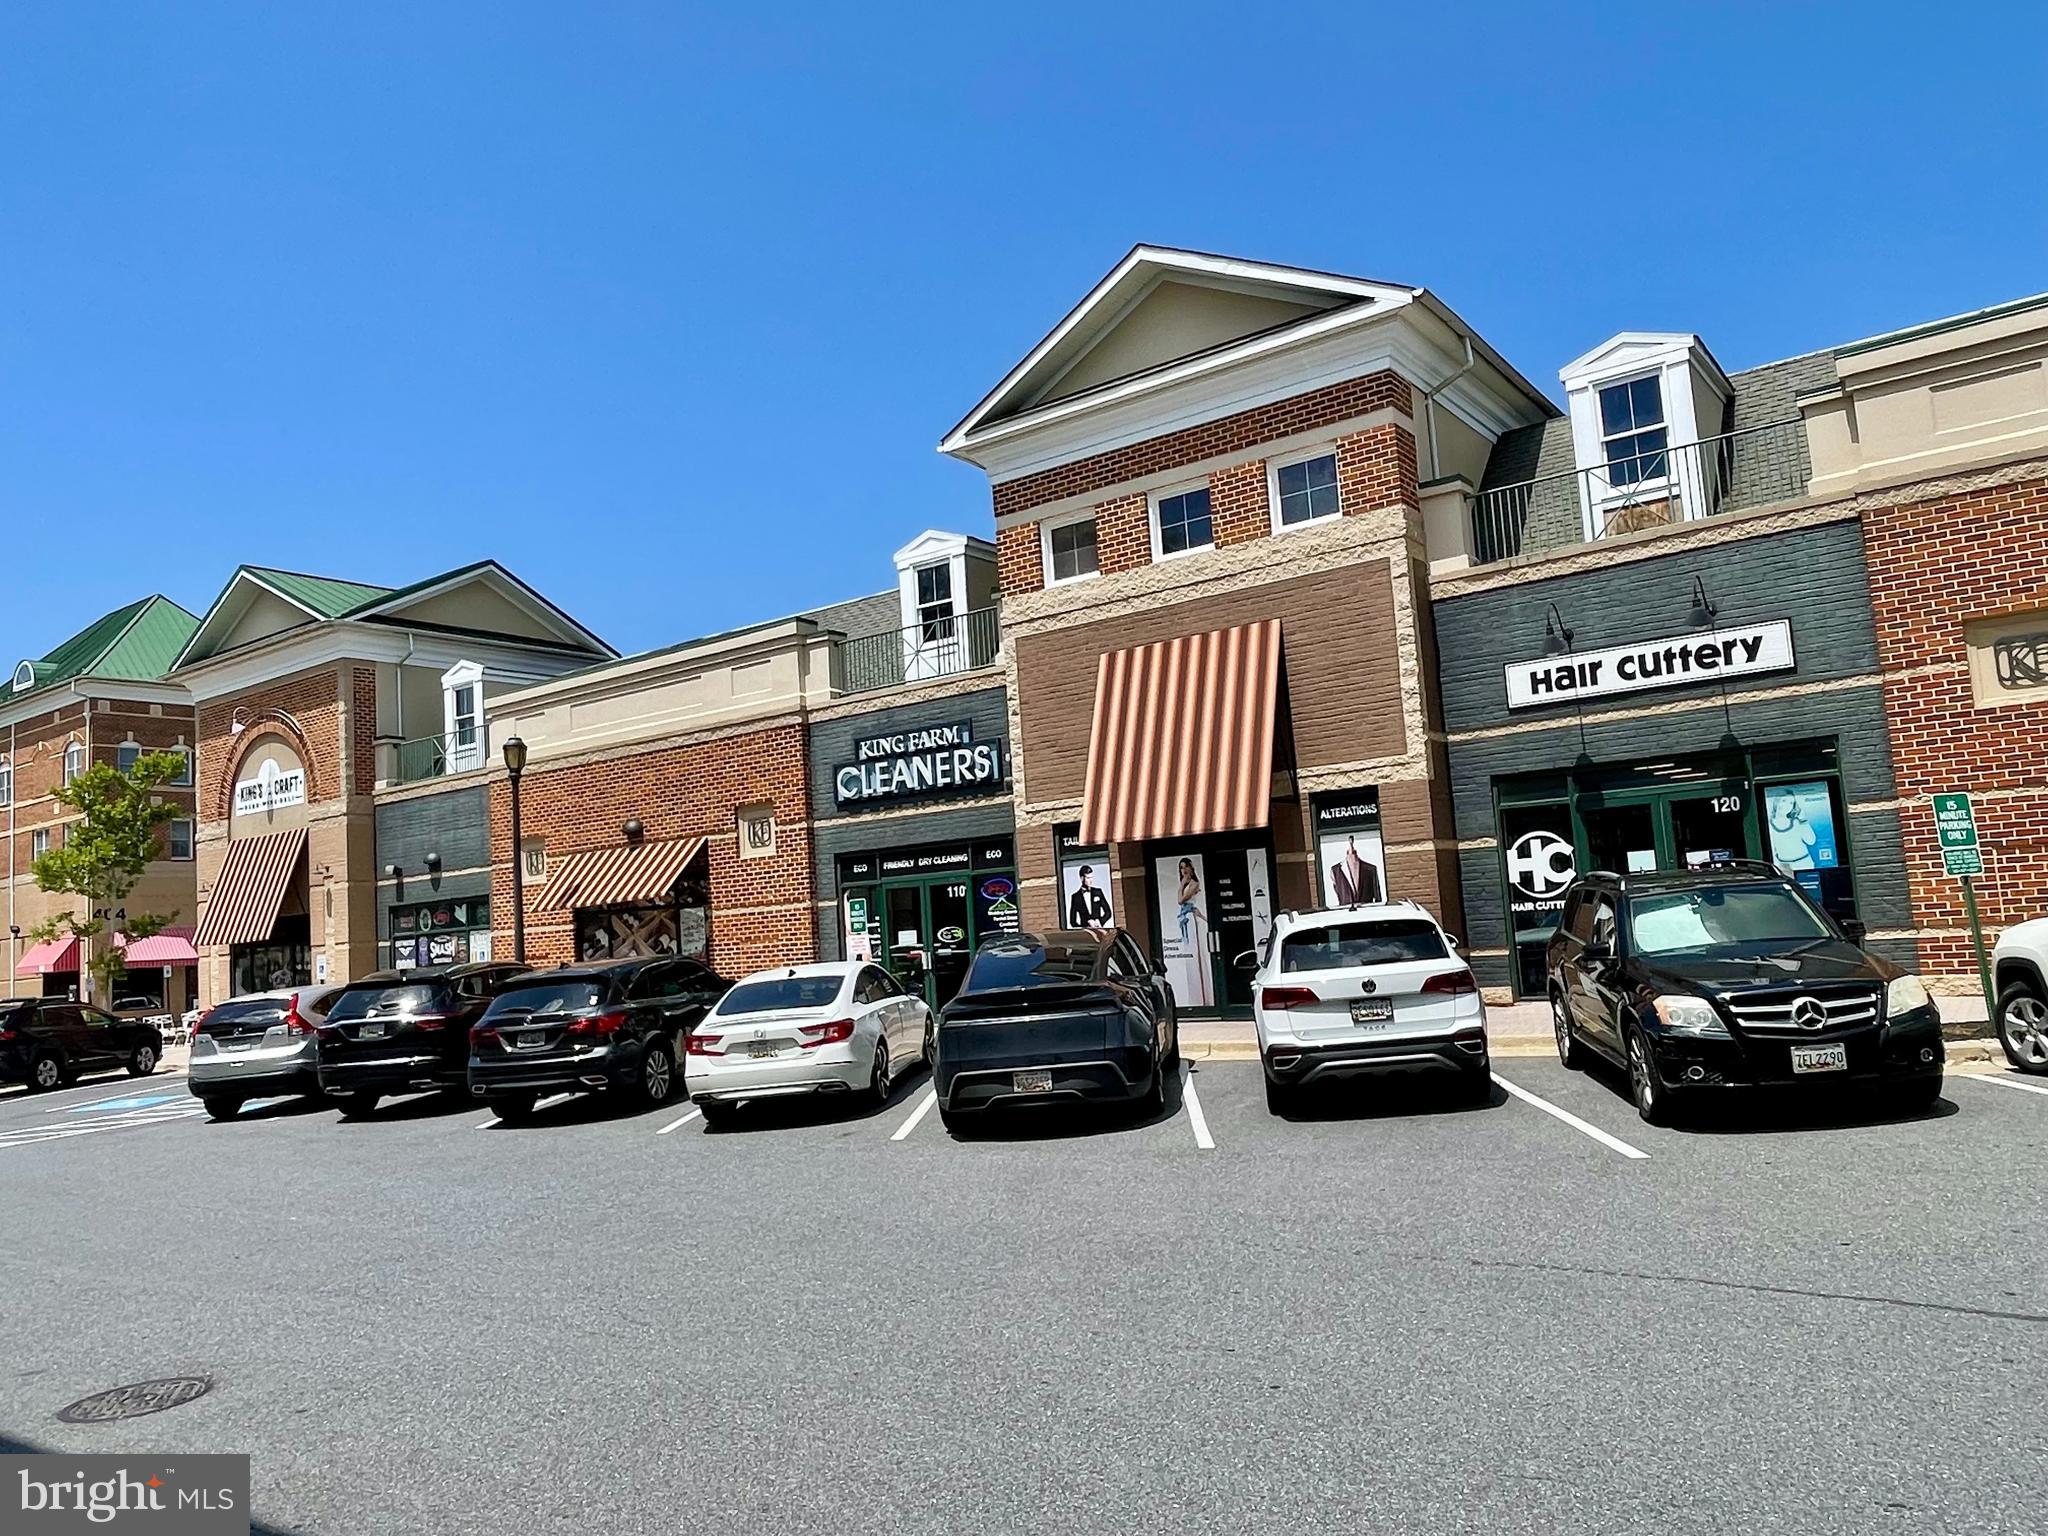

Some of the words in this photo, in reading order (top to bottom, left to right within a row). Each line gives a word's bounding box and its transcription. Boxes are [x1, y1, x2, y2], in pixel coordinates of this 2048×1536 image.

[1529, 659, 1603, 695] Hair
[859, 735, 905, 760] KING
[908, 725, 961, 751] FARM
[837, 745, 991, 798] CLEANERS
[274, 775, 299, 796] CRAFT
[1320, 803, 1378, 819] ALTERATIONS
[1711, 796, 1740, 813] 120
[1946, 801, 1957, 810] 15
[1939, 810, 1968, 820] MINUTE
[1939, 820, 1972, 830] PARKING
[1947, 831, 1967, 840] ONLY
[986, 850, 1002, 859] ECO
[883, 860, 914, 870] FRIENDLY
[918, 856, 932, 867] DRY
[933, 853, 969, 865] CLEANING
[853, 864, 868, 873] ECO
[947, 885, 967, 898] 110
[1511, 903, 1535, 912] HAIR
